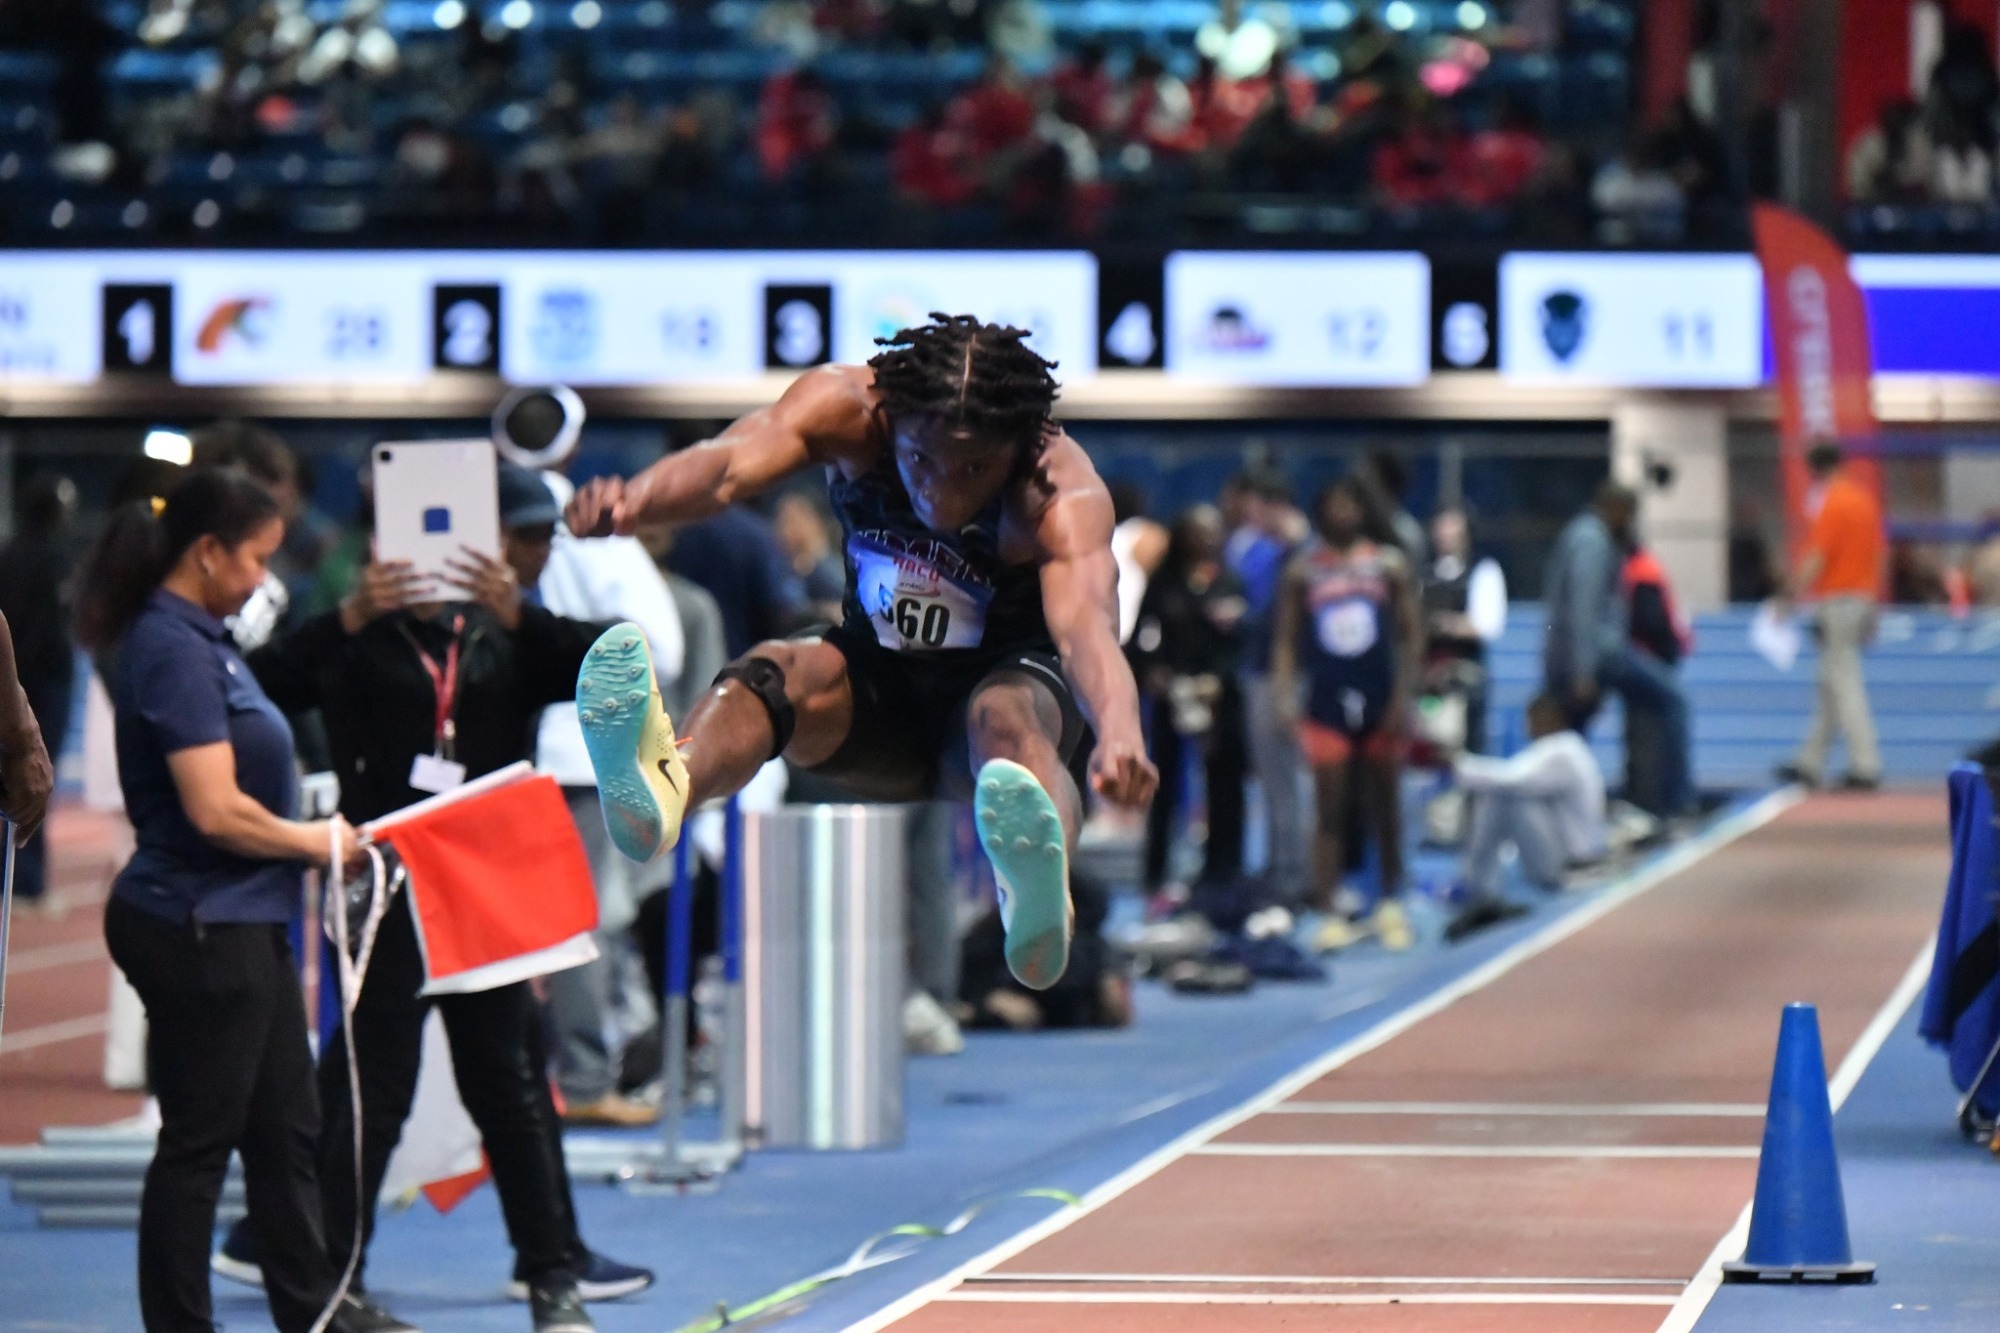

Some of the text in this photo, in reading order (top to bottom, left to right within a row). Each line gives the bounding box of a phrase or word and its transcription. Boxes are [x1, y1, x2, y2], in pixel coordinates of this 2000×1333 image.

[119, 300, 155, 364] 1
[443, 300, 491, 365] 2
[775, 300, 822, 366] 3
[1105, 302, 1155, 365] 4
